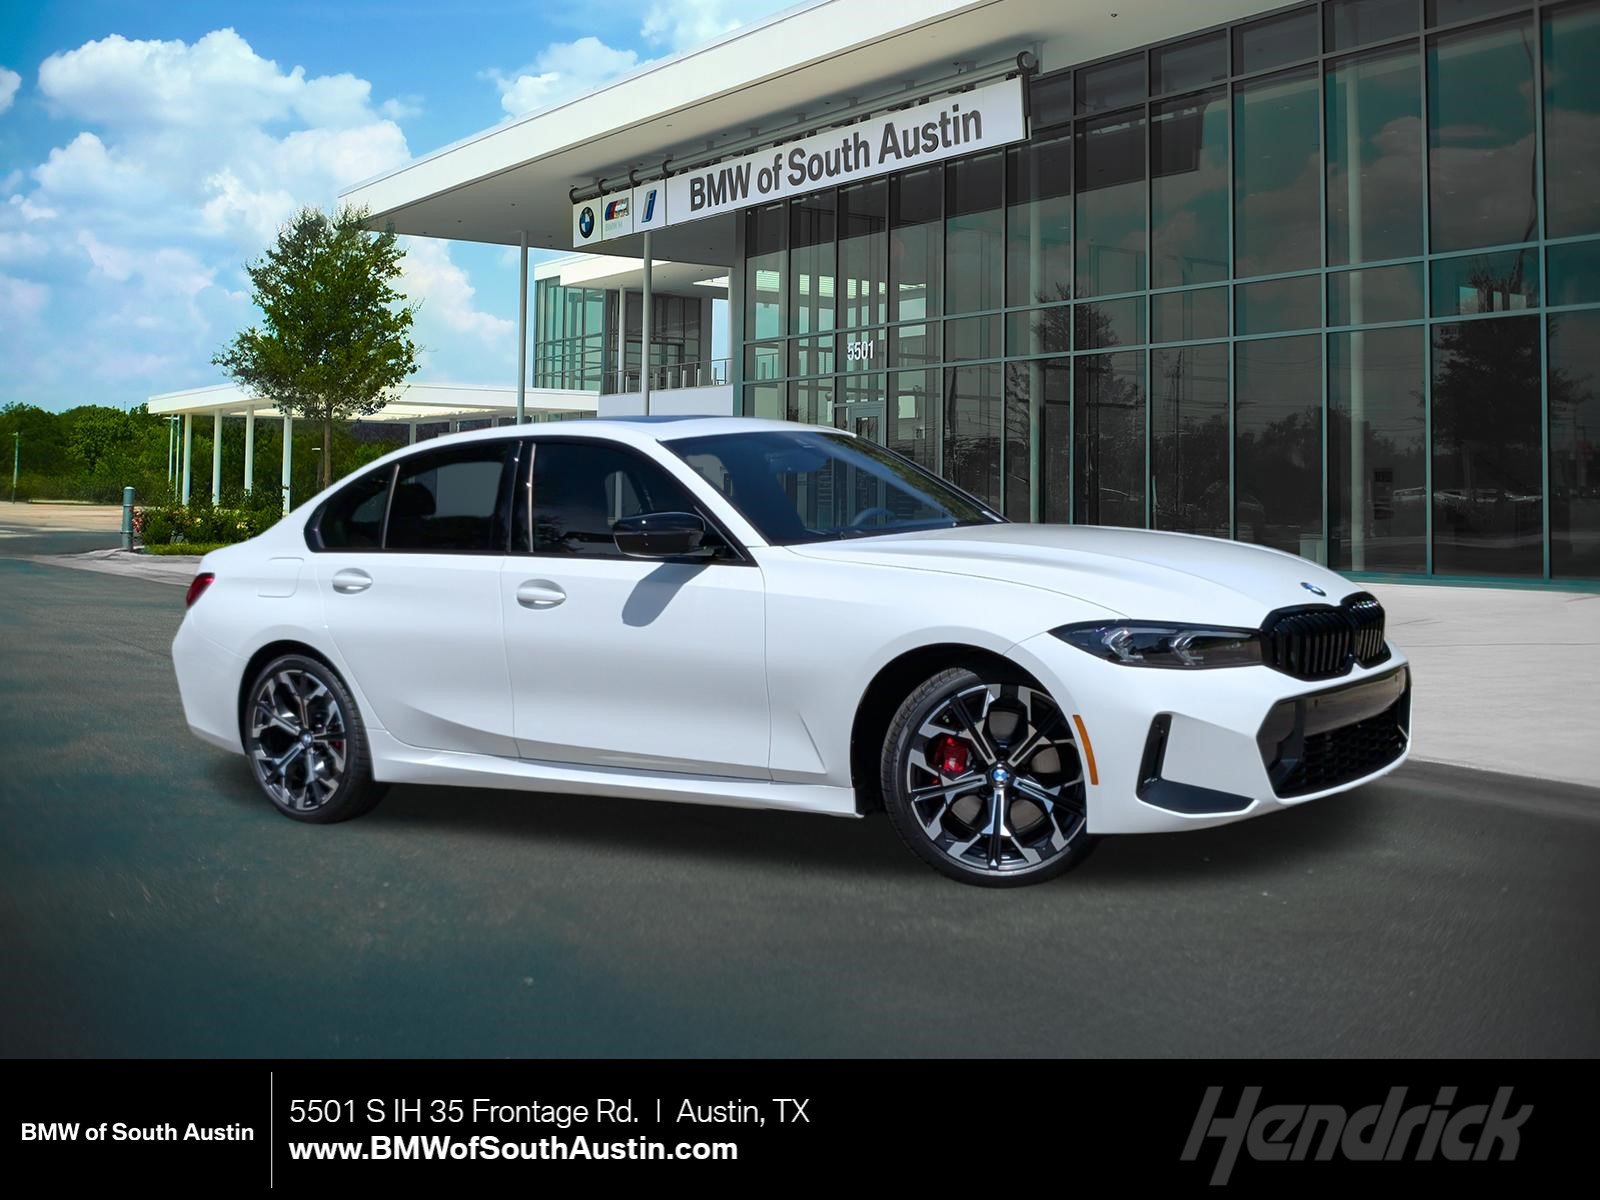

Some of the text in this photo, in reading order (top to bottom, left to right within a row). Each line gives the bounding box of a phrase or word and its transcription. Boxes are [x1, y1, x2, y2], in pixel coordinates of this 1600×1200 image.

[690, 162, 751, 212] BMW
[757, 153, 783, 194] of
[788, 132, 871, 186] South
[878, 103, 983, 164] Austin
[847, 340, 874, 361] 5501
